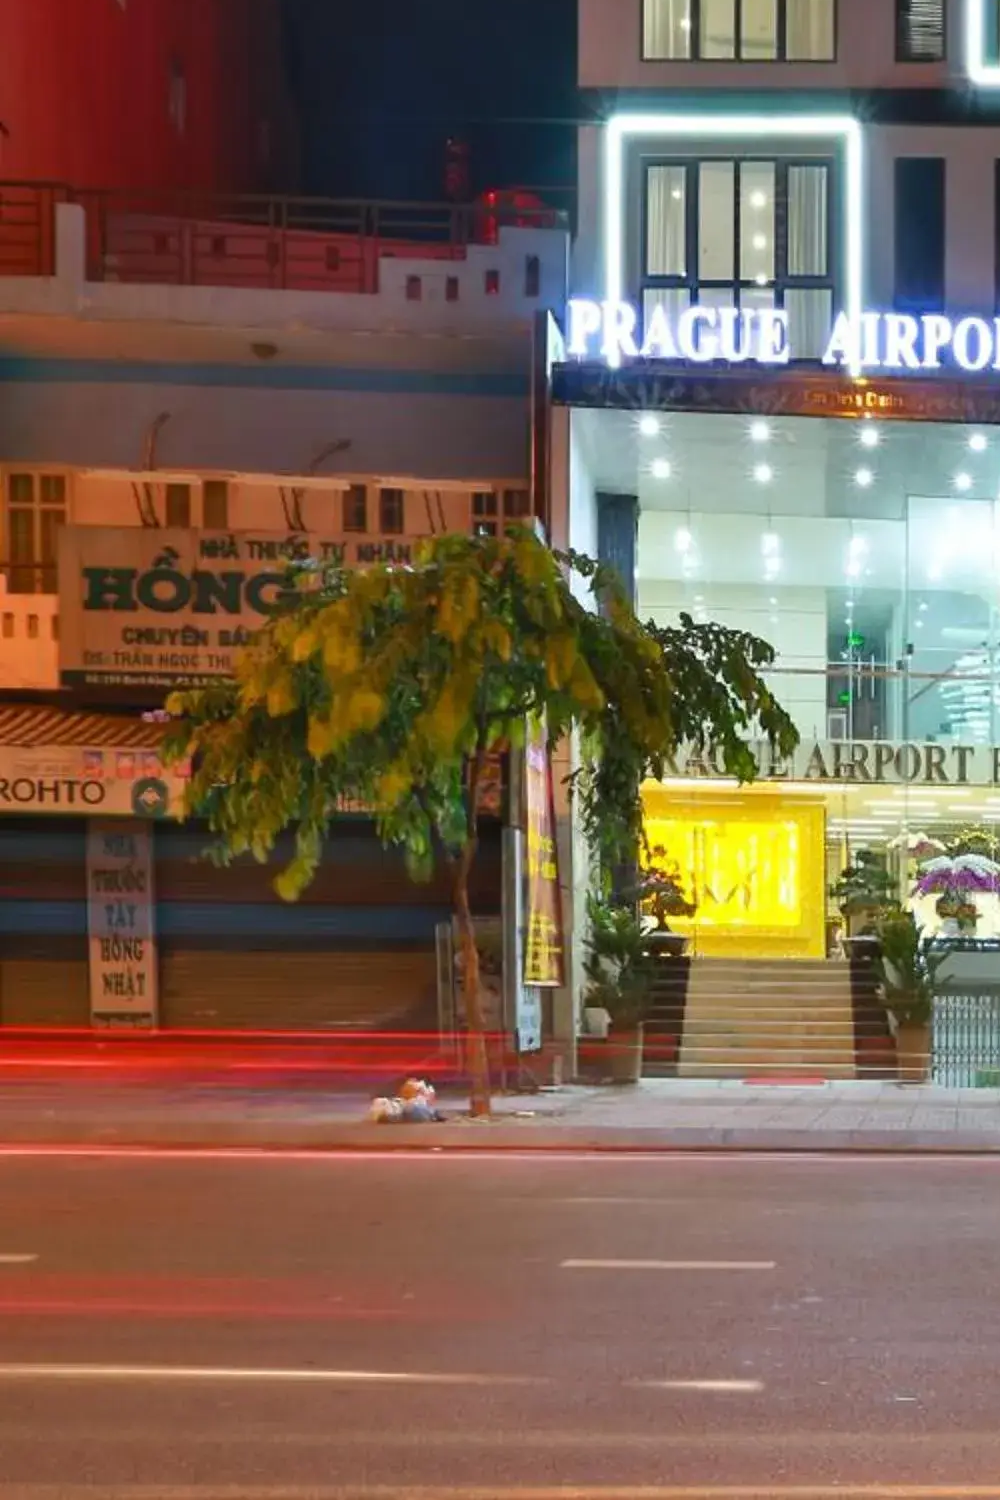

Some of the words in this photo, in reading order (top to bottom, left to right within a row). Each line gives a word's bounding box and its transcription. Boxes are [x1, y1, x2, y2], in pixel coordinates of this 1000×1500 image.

[567, 300, 790, 363] PRAGUE
[82, 546, 301, 615] HỒNG
[121, 625, 209, 647] CHUYÊN
[804, 740, 976, 783] AIRPORT
